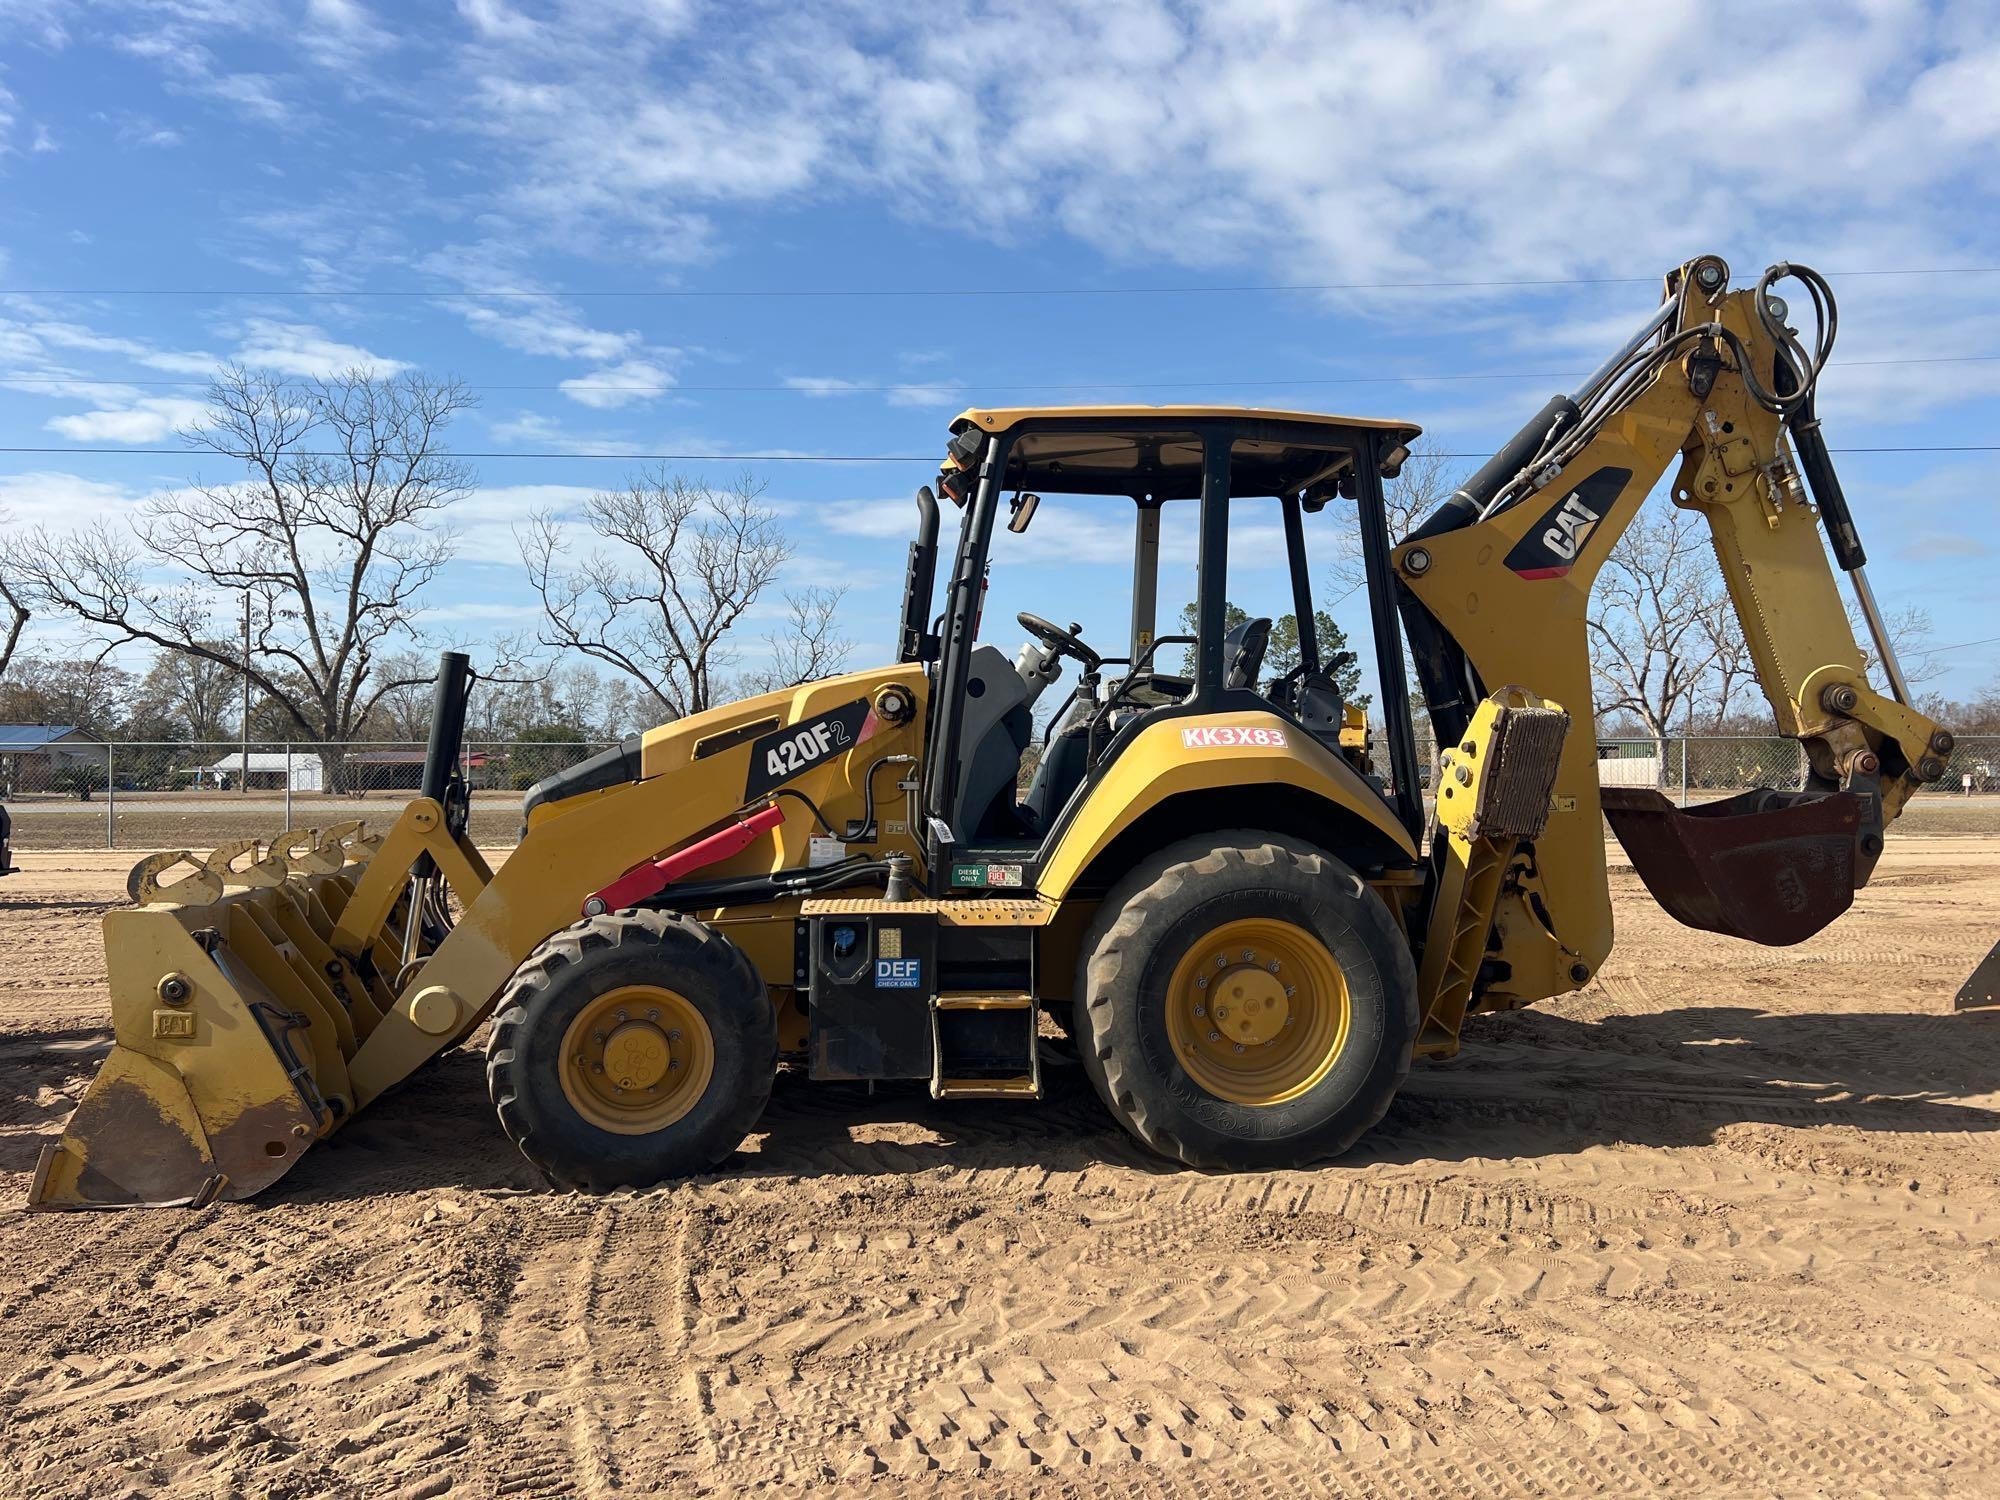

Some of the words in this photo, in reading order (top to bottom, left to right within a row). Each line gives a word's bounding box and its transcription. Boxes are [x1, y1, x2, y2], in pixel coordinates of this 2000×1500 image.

[1542, 491, 1600, 560] CAT
[1183, 728, 1285, 747] KK3X83
[766, 720, 850, 776] 420F2
[958, 868, 980, 876] DIESEL
[988, 871, 1006, 881] FUEL
[877, 961, 918, 978] DEF
[159, 1015, 191, 1035] CAT
